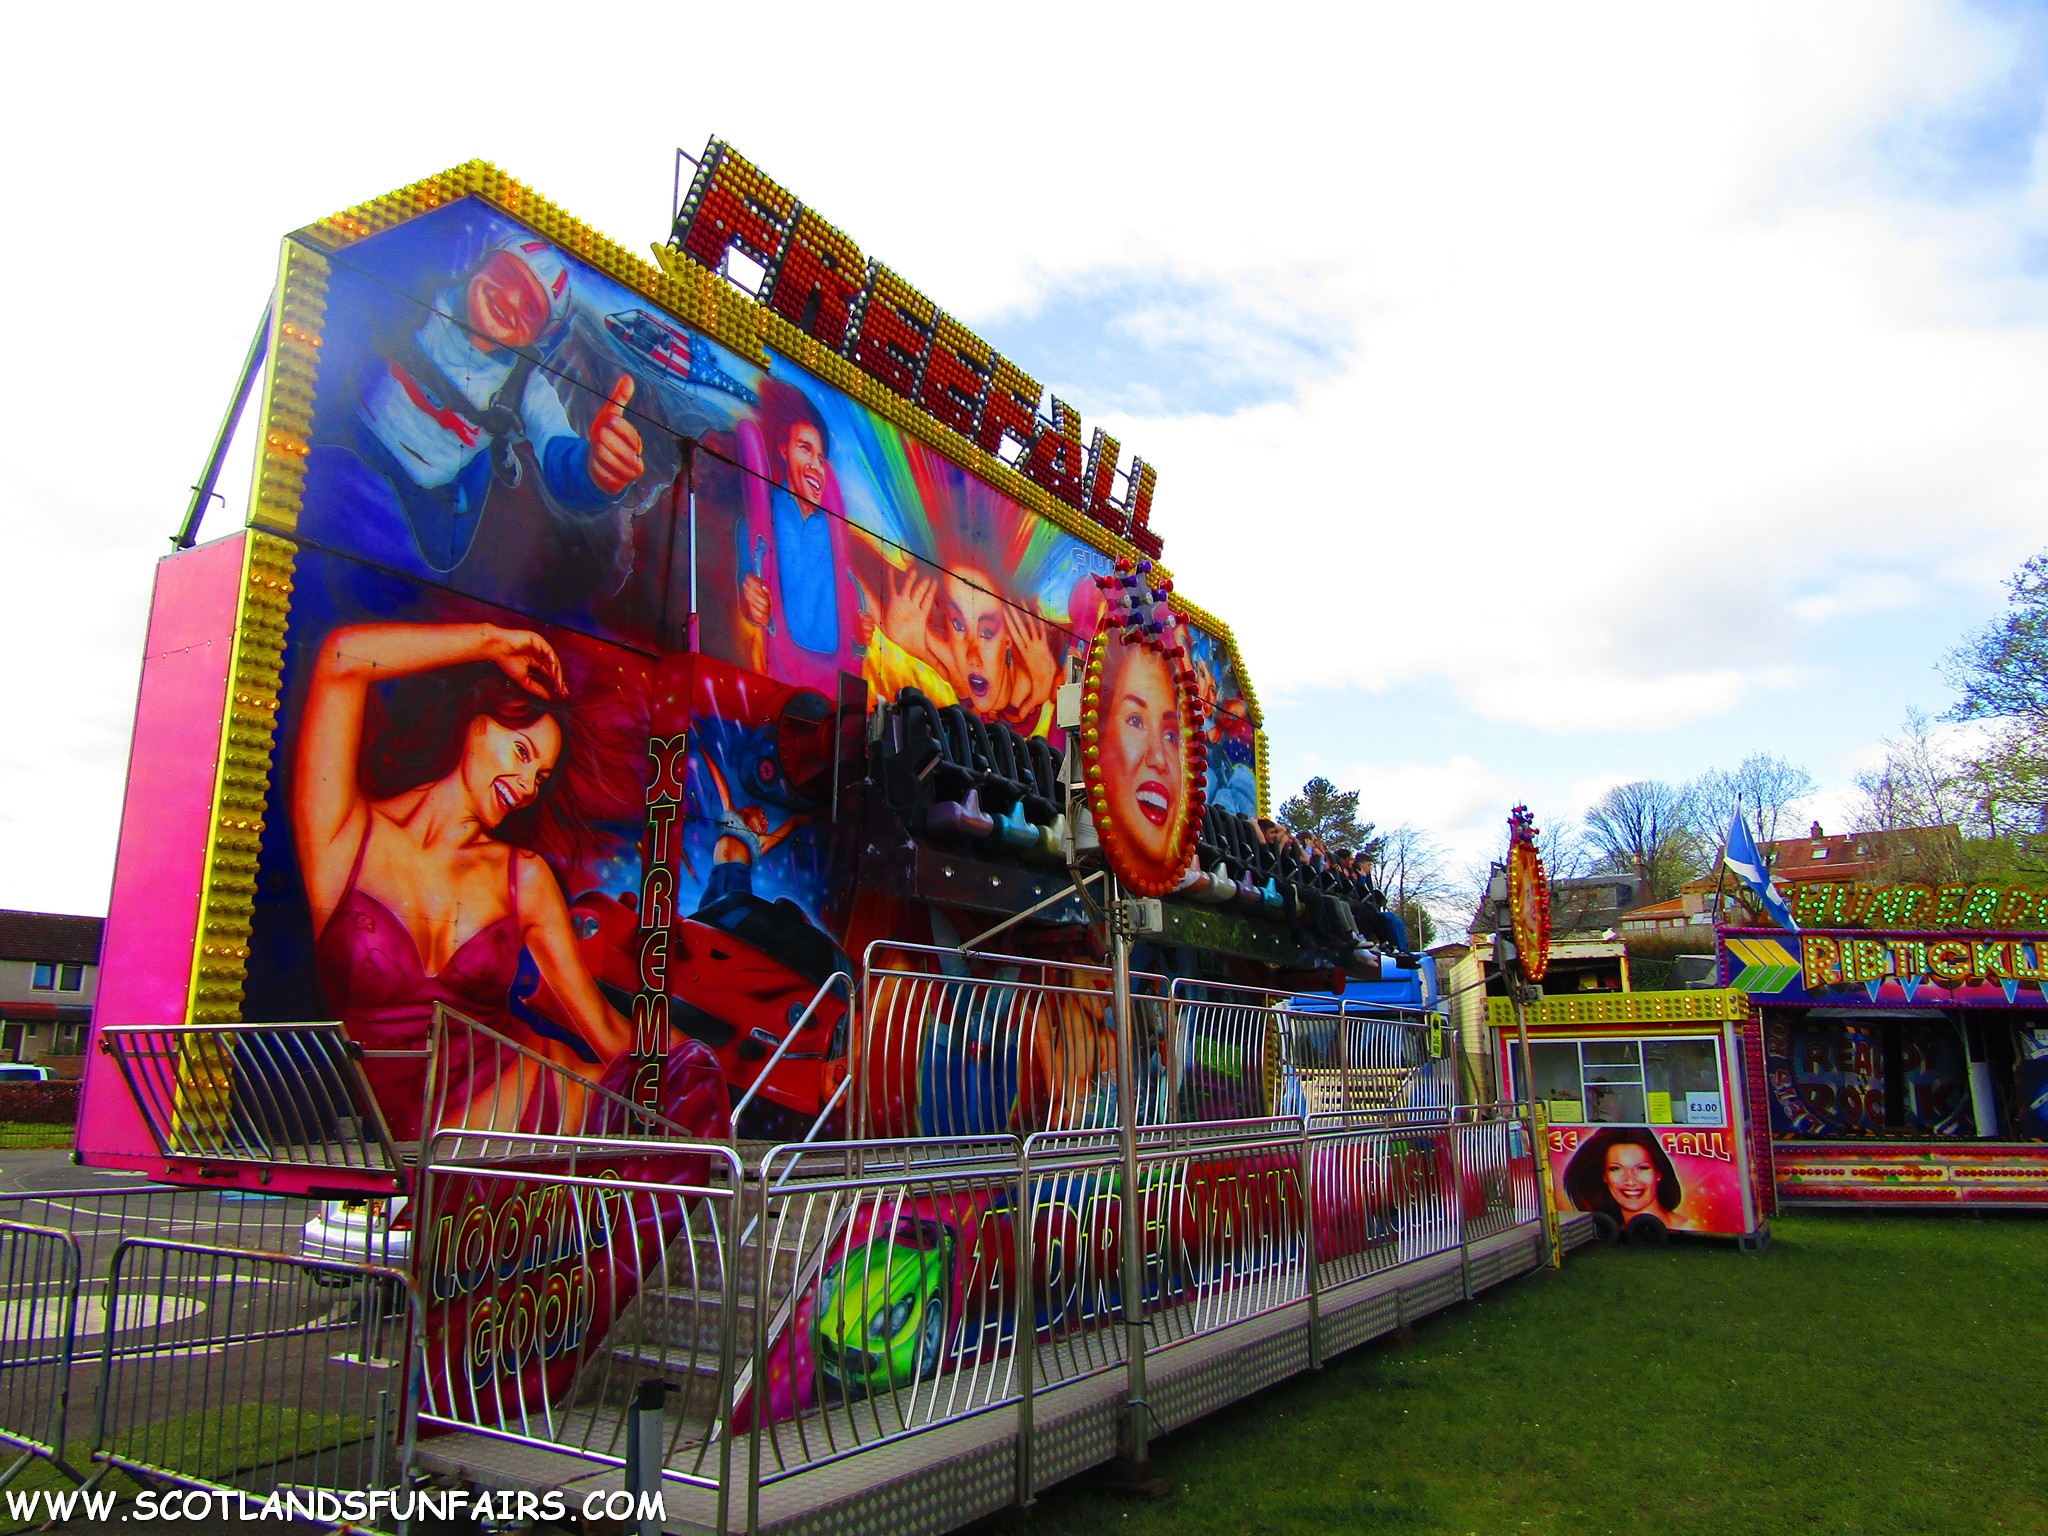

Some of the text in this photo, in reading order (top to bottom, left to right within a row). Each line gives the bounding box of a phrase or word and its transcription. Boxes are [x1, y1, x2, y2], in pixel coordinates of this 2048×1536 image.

[668, 134, 1164, 560] FREEFALL
[630, 733, 686, 1127] XTREME
[1549, 1130, 1732, 1162] EE FALL
[1690, 1102, 1718, 1112] £3.00
[433, 1168, 623, 1301] LOOKING
[463, 1264, 596, 1391] GOOD
